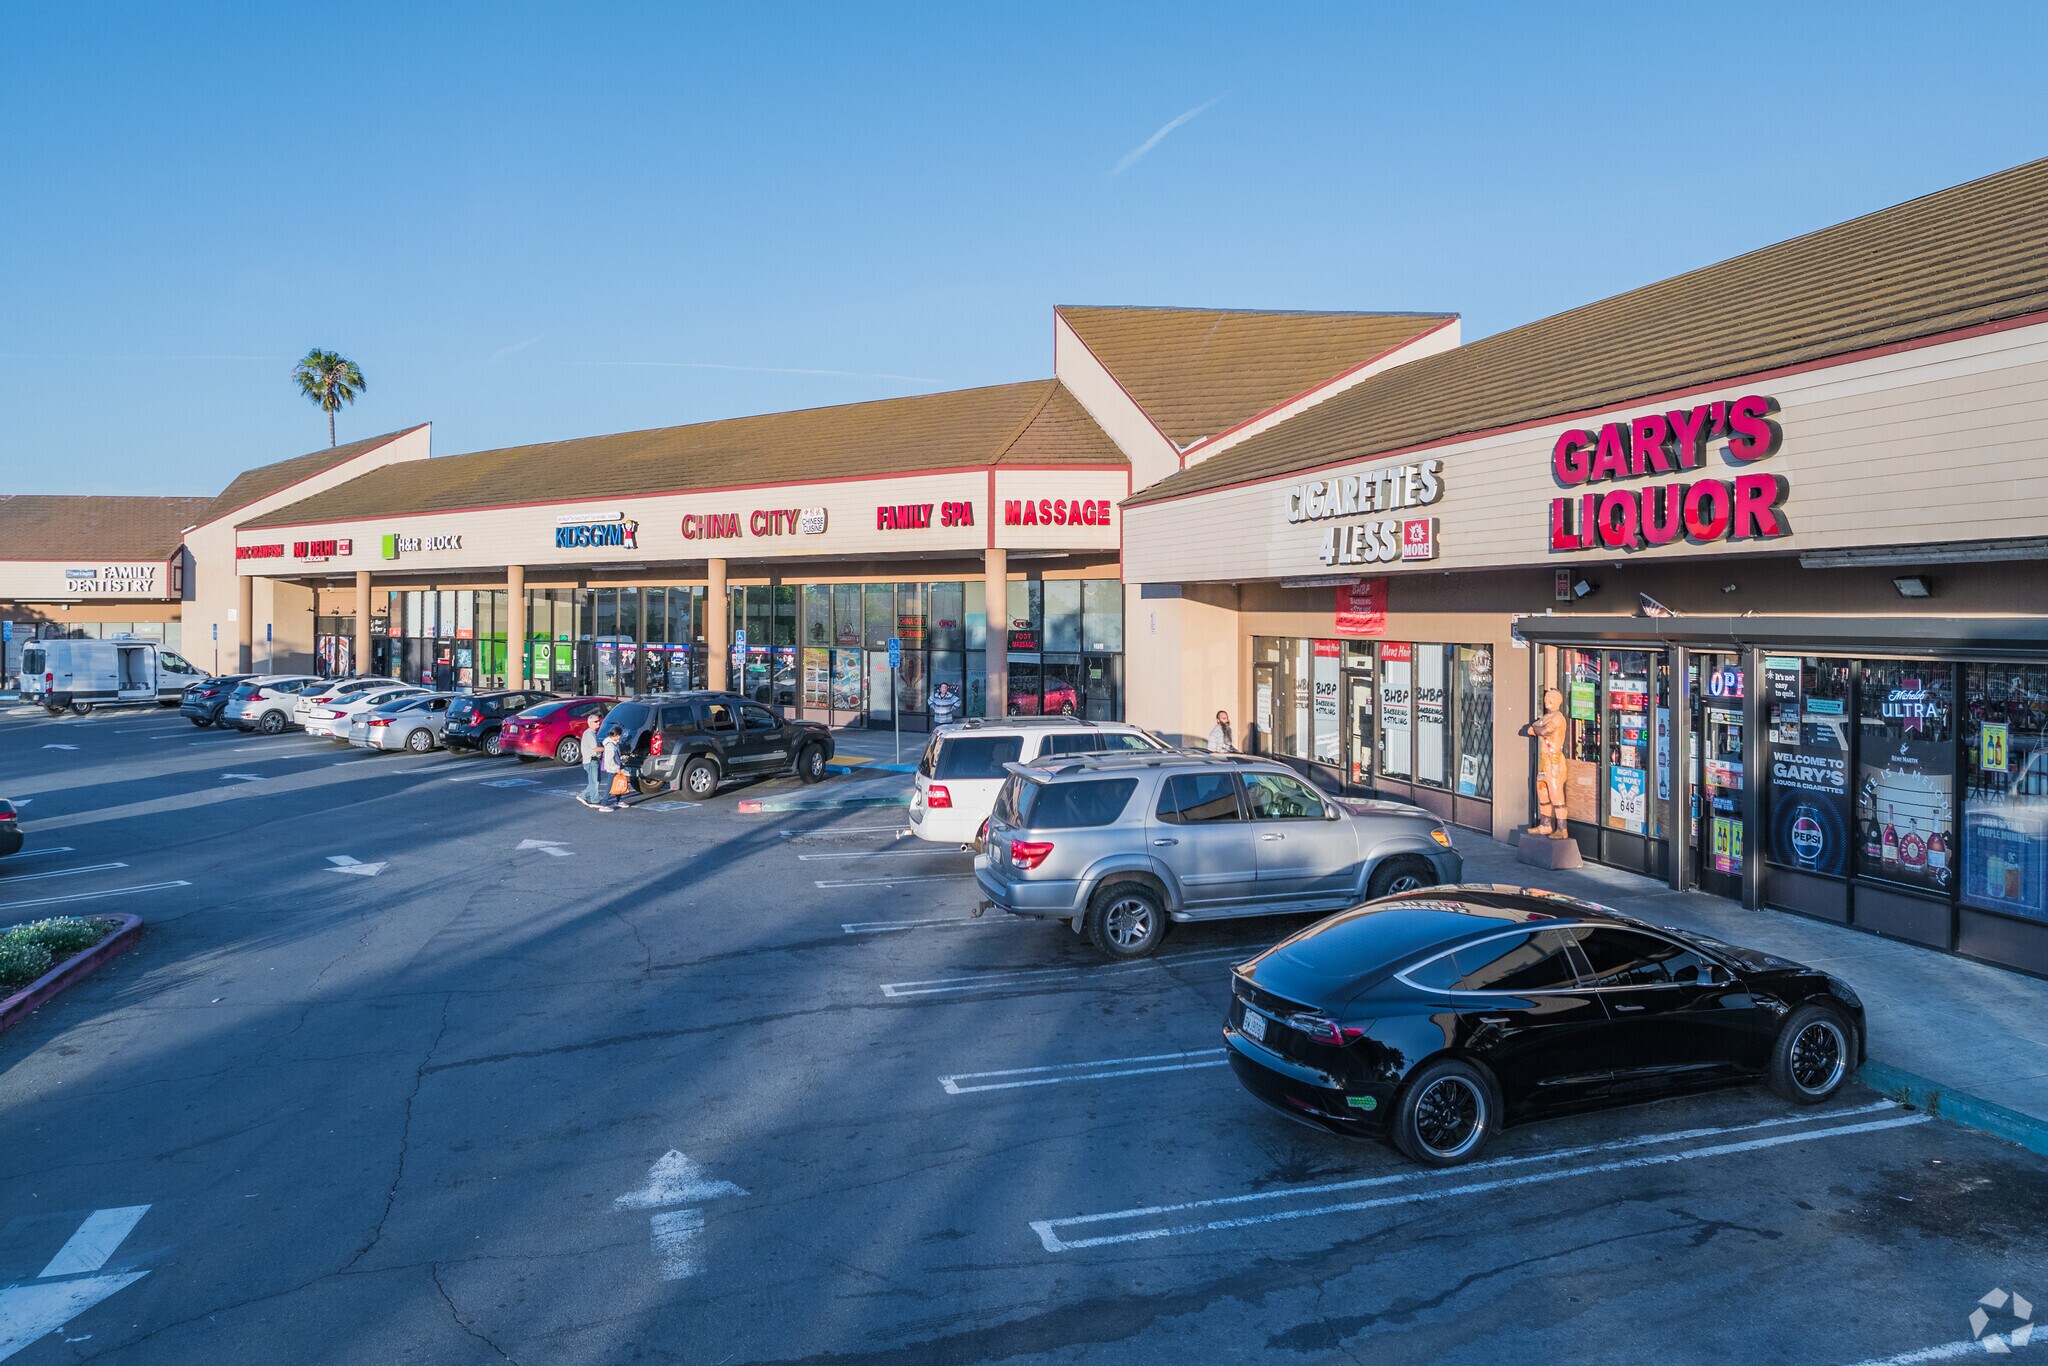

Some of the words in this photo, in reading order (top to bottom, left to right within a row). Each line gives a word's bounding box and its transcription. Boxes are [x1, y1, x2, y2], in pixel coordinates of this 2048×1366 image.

[1553, 394, 1782, 486] GARY'S
[1285, 459, 1443, 524] CIGARETTES
[877, 503, 934, 530] FAMILY
[941, 501, 975, 527] SPA
[1004, 499, 1111, 526] MASSAGE
[1551, 472, 1790, 553] LIQUOR
[681, 513, 742, 540] CHINA
[750, 508, 801, 537] CITY
[802, 517, 824, 525] CHINESE
[803, 525, 822, 533] CUISINE
[293, 541, 308, 557] NU
[310, 540, 337, 556] DELHI
[398, 538, 421, 552] H&R
[426, 535, 462, 550] BLOCK
[1319, 527, 1336, 566] 4
[1338, 519, 1400, 564] LESS
[1404, 543, 1429, 556] MORE
[102, 566, 155, 579] FAMILY
[66, 580, 154, 592] DENTISTRY
[1784, 674, 1795, 682] not
[1316, 682, 1337, 696] BHBP
[1384, 689, 1409, 703] BHBP
[1888, 690, 1926, 701] Michelob
[1383, 707, 1408, 716] BARBERING
[1882, 703, 1937, 718] ULTRA
[1773, 752, 1827, 767] WELCOME
[1828, 759, 1844, 769] TO
[1617, 768, 1632, 776] RIGHT
[1773, 763, 1844, 786] GARY'S
[1623, 776, 1641, 785] MONEY
[1773, 779, 1796, 788] LIQUOR
[1802, 783, 1844, 795] CIGARETTES
[1860, 777, 1878, 806] LIFE
[1880, 768, 1892, 780] IS
[1898, 767, 1905, 777] A
[1982, 817, 1998, 828] BEER
[1794, 831, 1820, 845] PEPSI
[1977, 827, 2000, 839] PEOPLE
